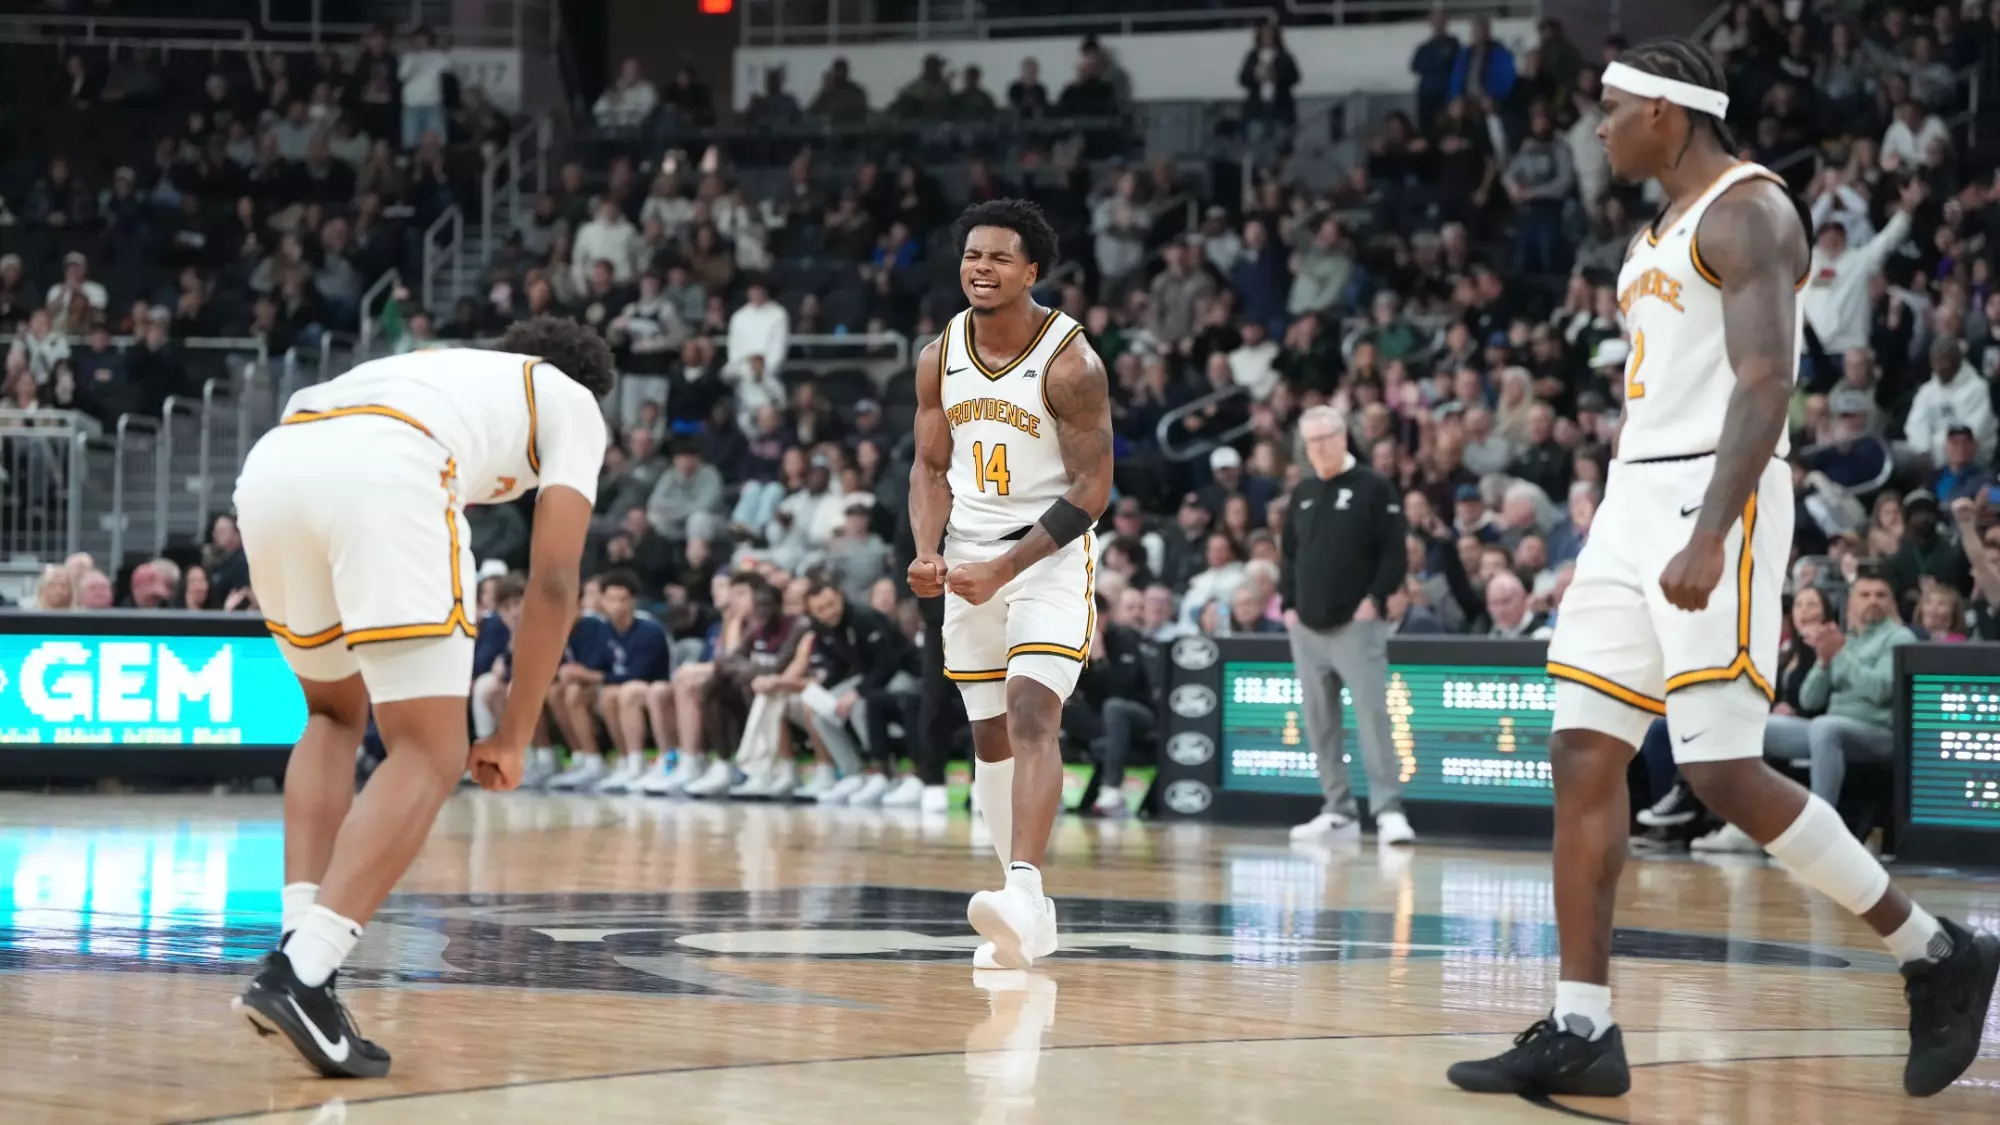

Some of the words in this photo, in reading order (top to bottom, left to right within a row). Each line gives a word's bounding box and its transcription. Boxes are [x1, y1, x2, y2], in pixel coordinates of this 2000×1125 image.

[946, 397, 1040, 438] PROVIDENCE
[972, 440, 1010, 496] 14
[19, 641, 233, 722] GEM
